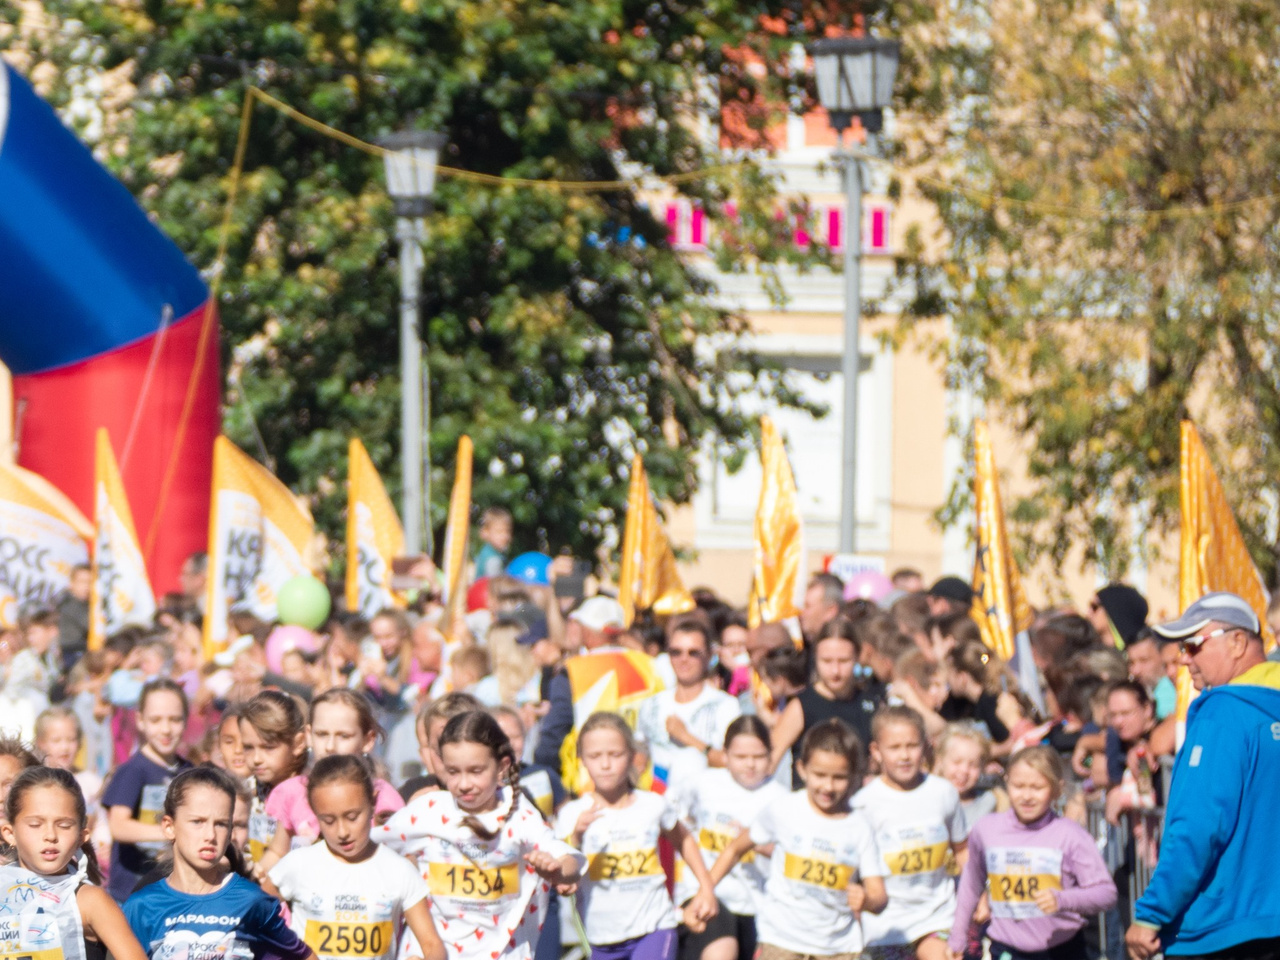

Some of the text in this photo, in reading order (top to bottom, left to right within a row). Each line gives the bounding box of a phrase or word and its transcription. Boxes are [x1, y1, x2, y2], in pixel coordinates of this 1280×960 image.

[446, 866, 504, 896] 1534
[801, 859, 838, 887] 235
[319, 924, 382, 954] 2590
